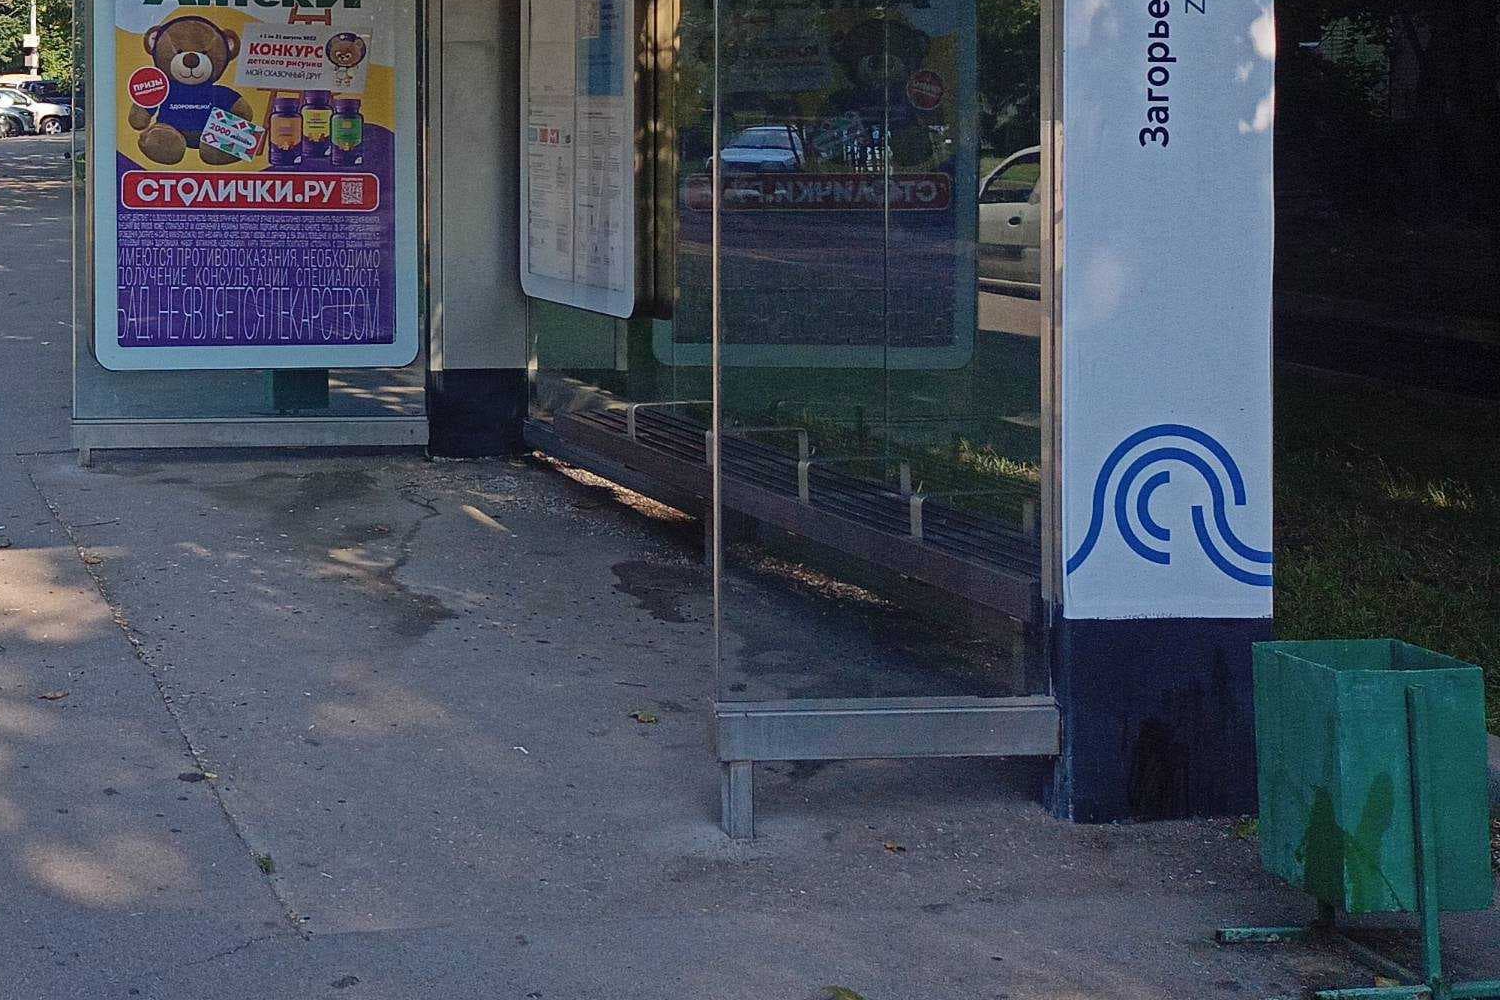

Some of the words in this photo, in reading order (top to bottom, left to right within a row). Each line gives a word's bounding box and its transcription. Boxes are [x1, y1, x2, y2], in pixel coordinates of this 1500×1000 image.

[249, 43, 324, 58] КОНКУРС
[247, 58, 284, 66] детского
[285, 60, 323, 69] рисунка
[133, 78, 164, 92] ПРИЗЫ
[136, 178, 336, 206] СТОЛИЧКИ.РУ
[118, 247, 173, 267] ИМЕЮТСЯ
[303, 248, 380, 268] НЕОБХОДИМО
[118, 266, 188, 286] ПОЛУЧЕНИЕ
[195, 267, 288, 287] КОНСУЛЬТАЦИИ
[296, 268, 380, 287] СПЕЦИАЛИСТА
[158, 286, 180, 339] НЕ
[182, 286, 266, 339] ЯВЛЯЕТСЯ
[268, 287, 380, 340] ЛЕКАРСТВОМ
